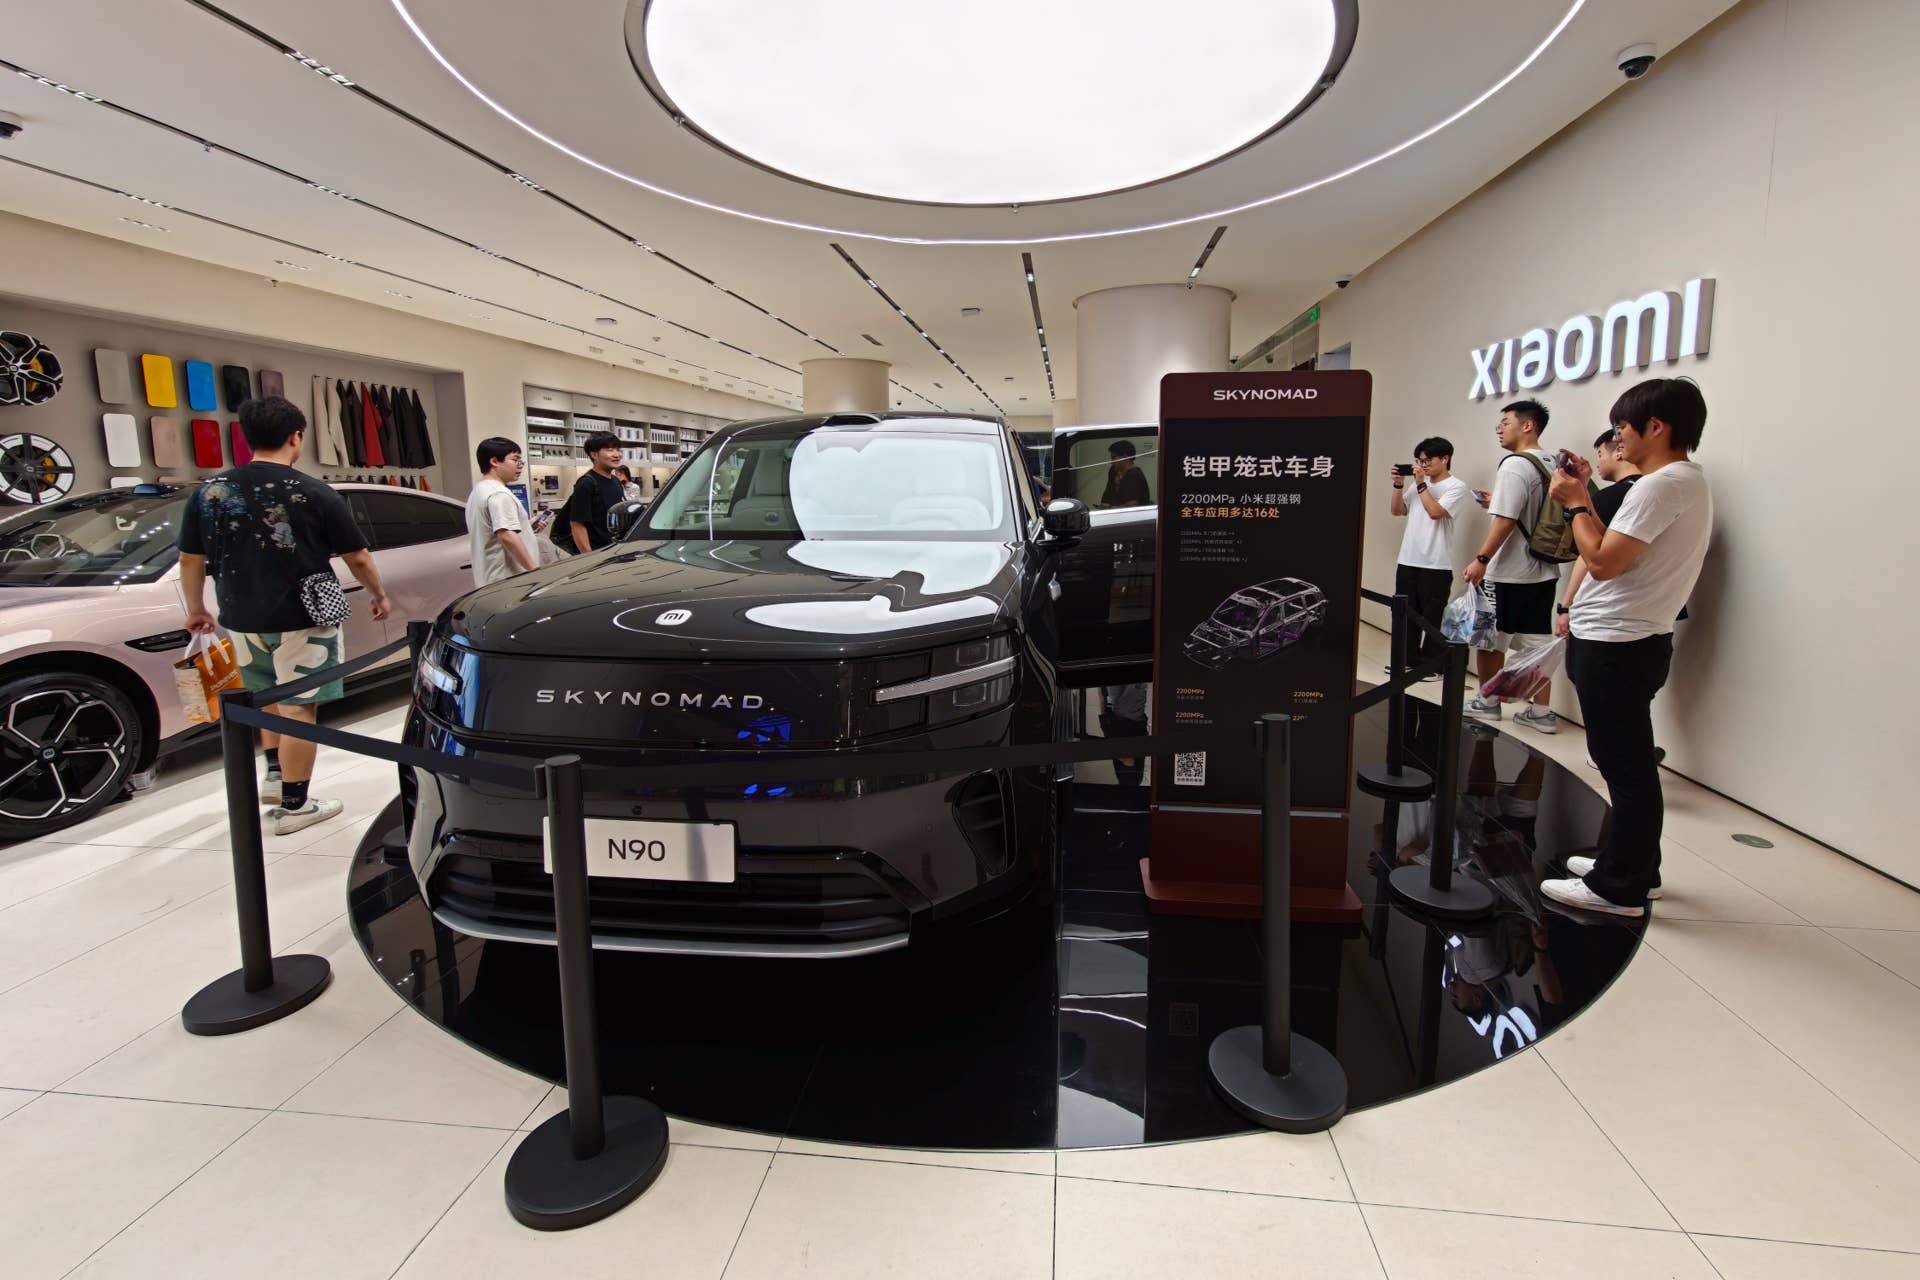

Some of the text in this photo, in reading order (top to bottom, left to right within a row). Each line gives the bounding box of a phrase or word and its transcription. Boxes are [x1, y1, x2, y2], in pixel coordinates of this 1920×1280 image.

[1468, 278, 1708, 400] xiaomi
[1213, 388, 1318, 401] SKYNOMAD
[1182, 455, 1335, 478] 铠甲笼式车身
[1181, 493, 1301, 505] 2200MPa 小米超强钢
[1181, 506, 1280, 518] 全车应用多达16处
[536, 689, 763, 709] SKYNOMAD
[608, 838, 666, 862] N90
